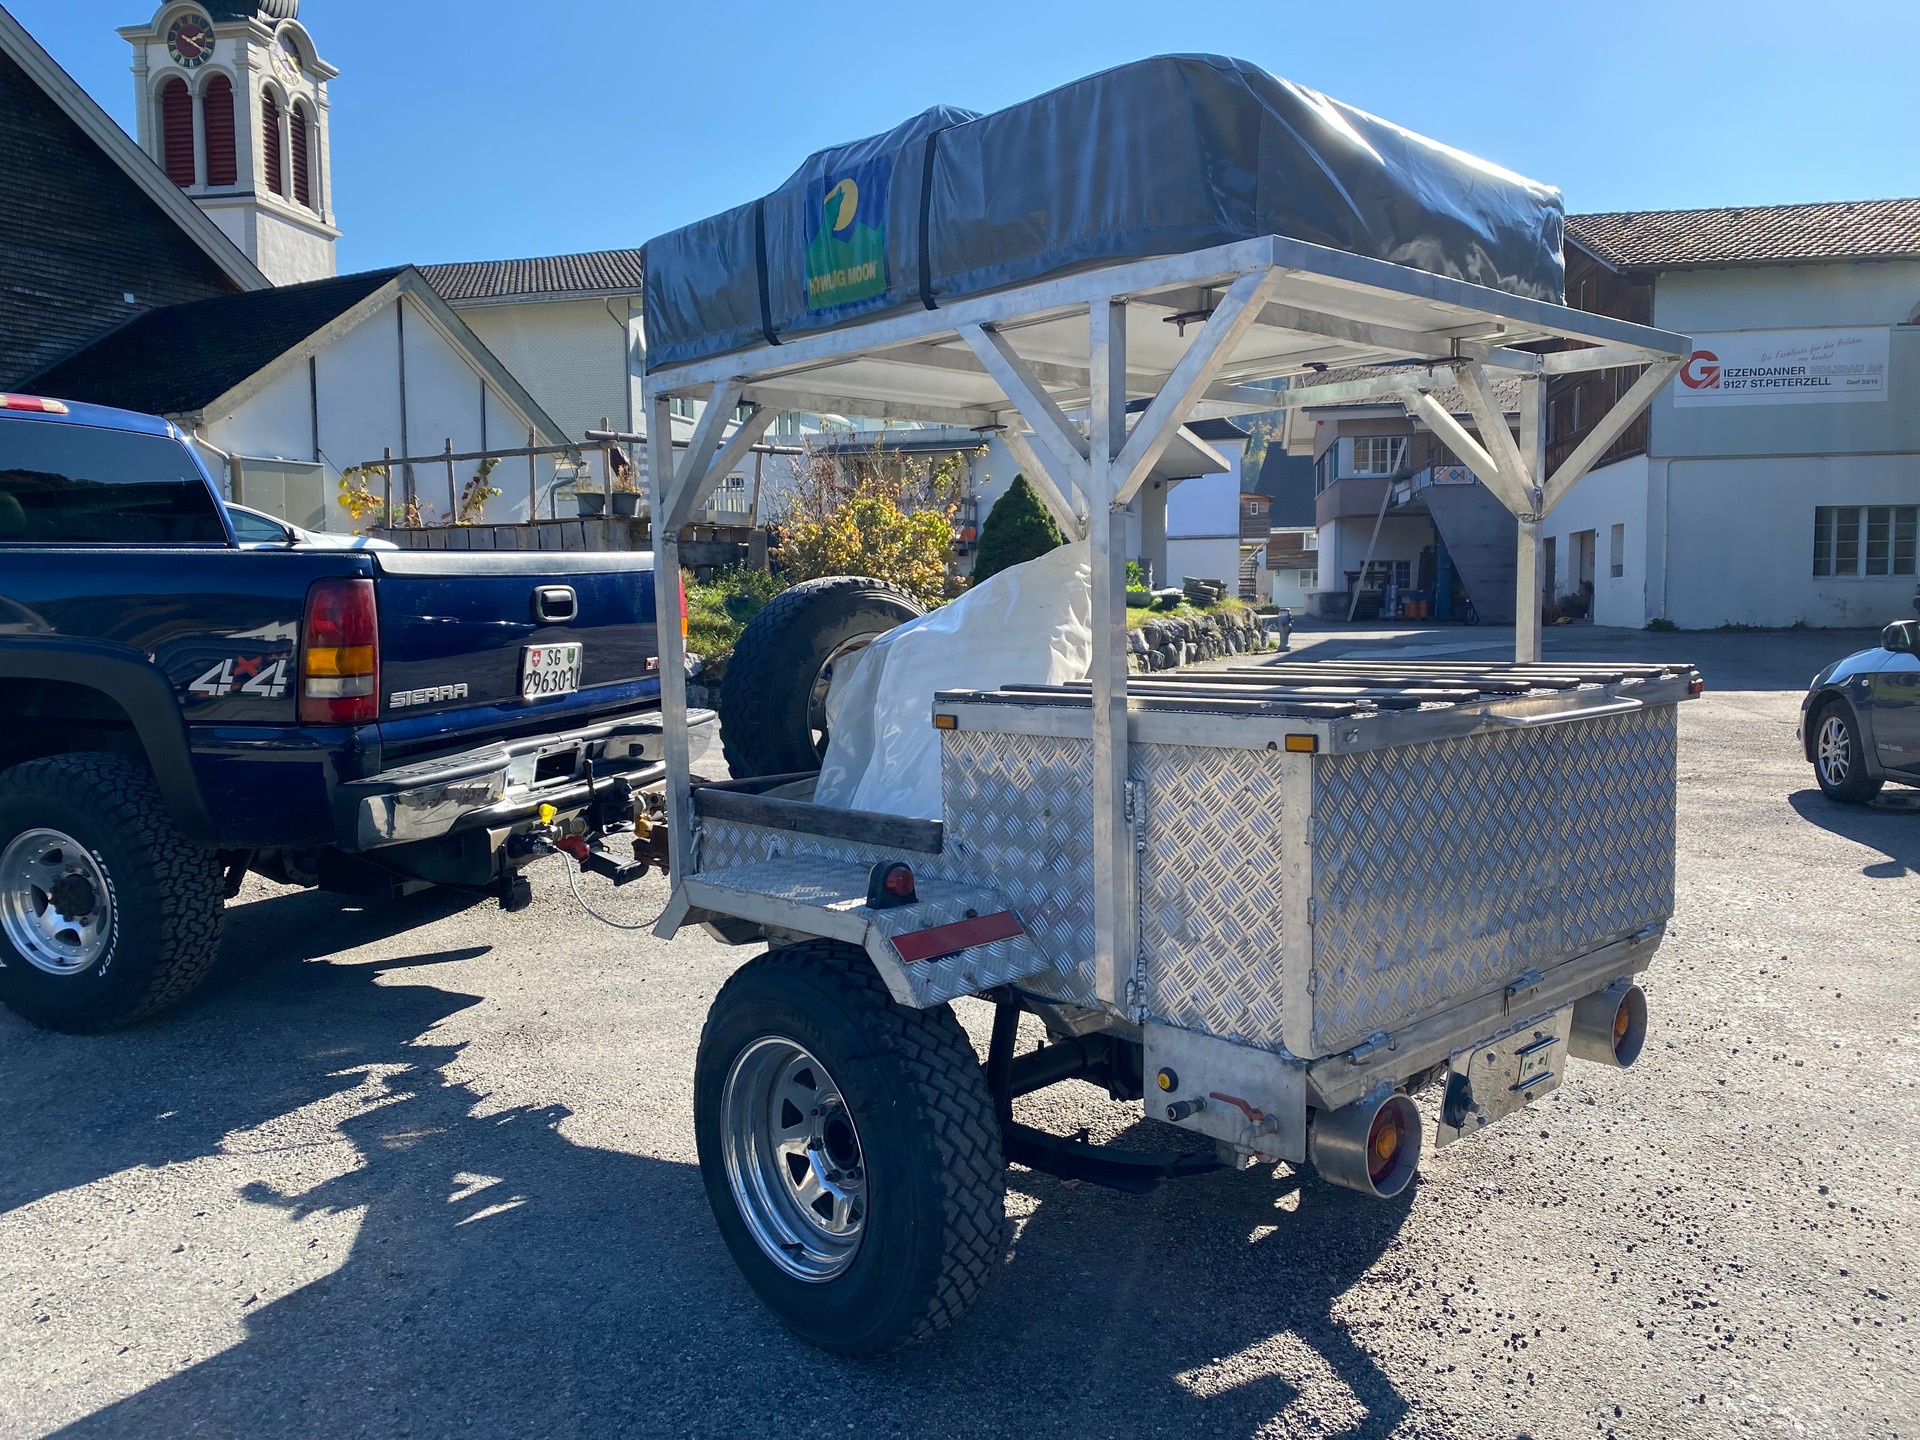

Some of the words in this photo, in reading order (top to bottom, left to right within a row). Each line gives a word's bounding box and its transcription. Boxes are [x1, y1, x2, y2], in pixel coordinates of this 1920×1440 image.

[848, 261, 877, 285] MOON
[1866, 363, 1884, 373] AG
[1723, 379, 1748, 389] 9127
[1846, 378, 1861, 386] Dorf
[547, 648, 561, 666] SG
[389, 683, 468, 708] SIERRA
